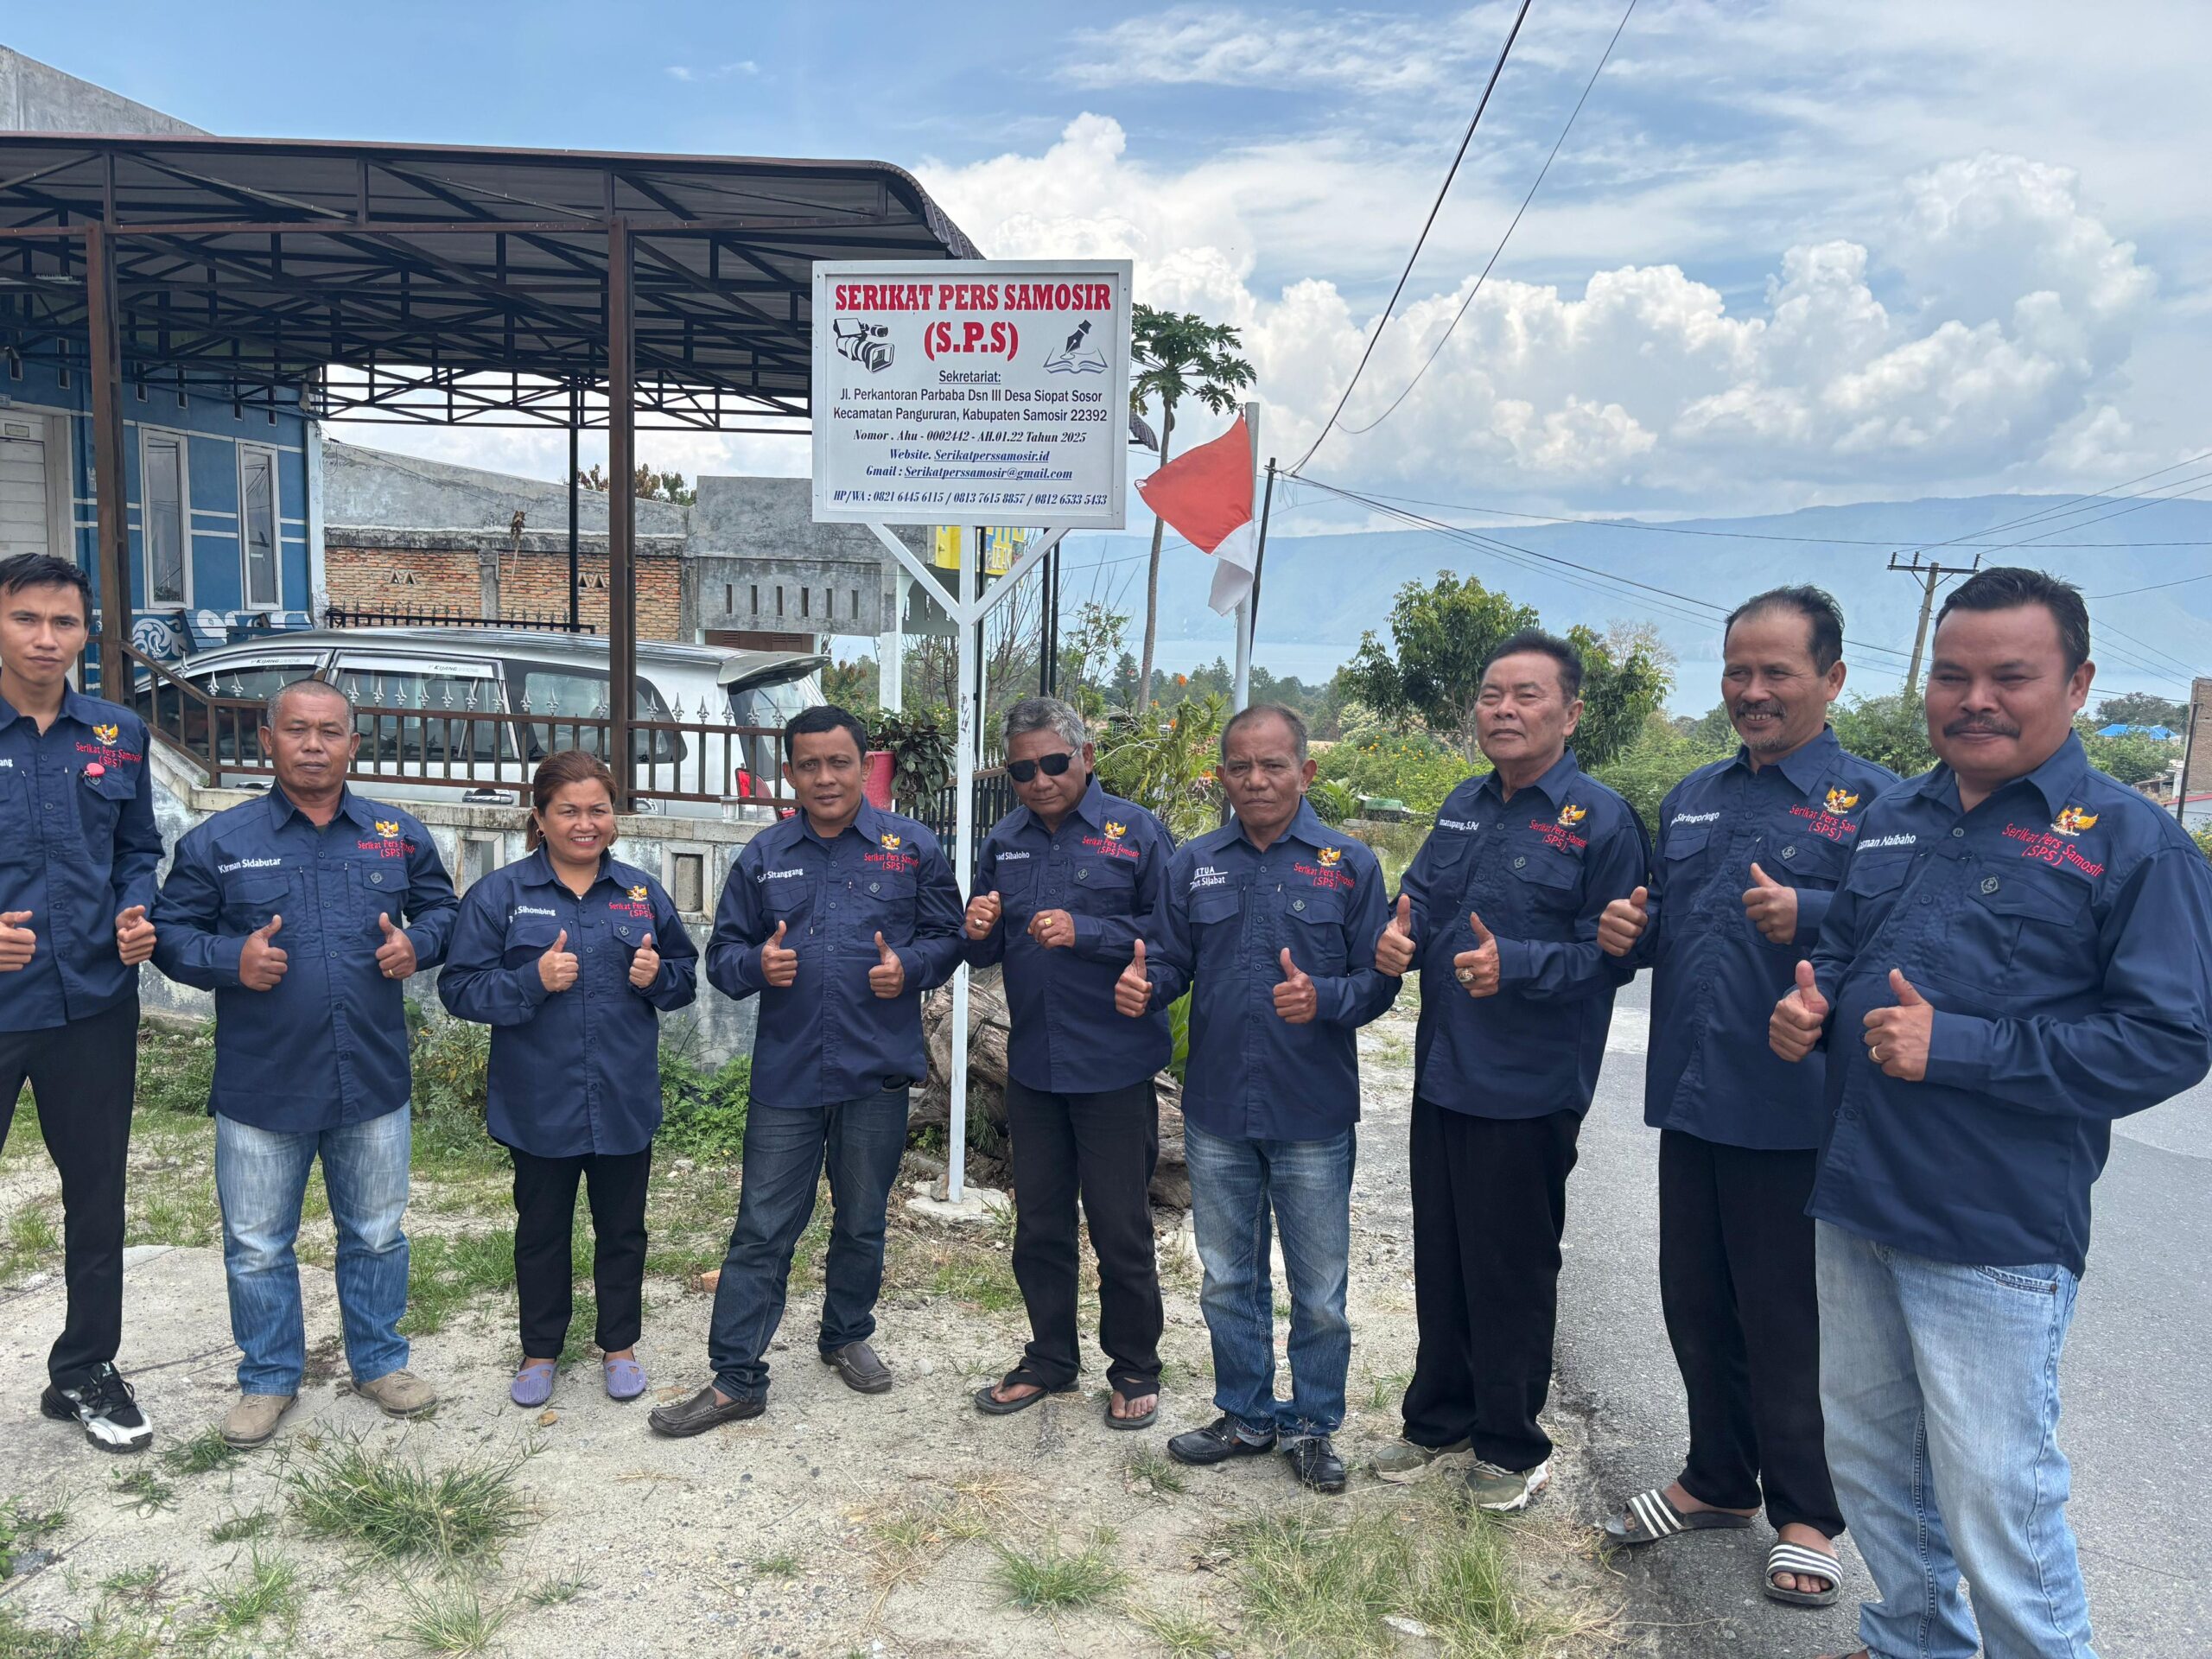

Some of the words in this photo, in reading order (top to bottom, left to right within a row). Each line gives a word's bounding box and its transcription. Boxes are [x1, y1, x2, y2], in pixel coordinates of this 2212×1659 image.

[836, 284, 933, 311] SERIKAT
[938, 284, 999, 311] PERS
[1004, 283, 1111, 311] SAMOSIR
[924, 321, 1019, 362] (S.P.S)
[938, 370, 1001, 384] Sekretariat:
[840, 388, 850, 400] Jl.
[854, 388, 918, 401] Perkantoran
[921, 389, 965, 401] Parbaba
[968, 389, 988, 401] Dsn
[992, 390, 1001, 402] III
[1005, 390, 1031, 402] Desa
[1034, 390, 1069, 404] Siopat
[1071, 390, 1103, 402] Sosor
[834, 407, 893, 419] Kecamatan
[896, 407, 960, 423] Pangururan,
[963, 408, 1020, 423] Kabupaten
[1023, 409, 1068, 421] Samosir
[1071, 410, 1108, 422] 22392
[853, 429, 889, 441] Nomor
[897, 430, 918, 442] Ahu
[926, 430, 970, 442] 0002442
[1026, 431, 1058, 442] Tahun
[1060, 432, 1088, 442] 2025
[890, 448, 931, 460] Website.
[934, 449, 1051, 463] Serikatperssamosir.id
[866, 465, 897, 477] Gmail
[904, 466, 1073, 480] Serikatperssamosir@gmail.com
[834, 490, 865, 504] HP/WA
[873, 491, 895, 502] 0821
[953, 493, 976, 504] 0813
[978, 493, 1001, 504] 7615
[1002, 493, 1026, 505] 8857
[1034, 493, 1058, 505] 0812
[1059, 494, 1083, 505] 6533
[1789, 804, 1818, 820] Serikat
[1819, 810, 1839, 826] Pers
[1808, 820, 1842, 842] (SPS)
[1879, 832, 1916, 847] Naibaho
[2002, 823, 2040, 843] Serikat
[2037, 832, 2063, 849] Pers
[2062, 844, 2105, 878] Samosir
[2022, 845, 2064, 867] (SPS)
[241, 858, 282, 868] Sidabutar
[1319, 867, 1334, 877] Pers
[518, 906, 556, 917] Sihombing
